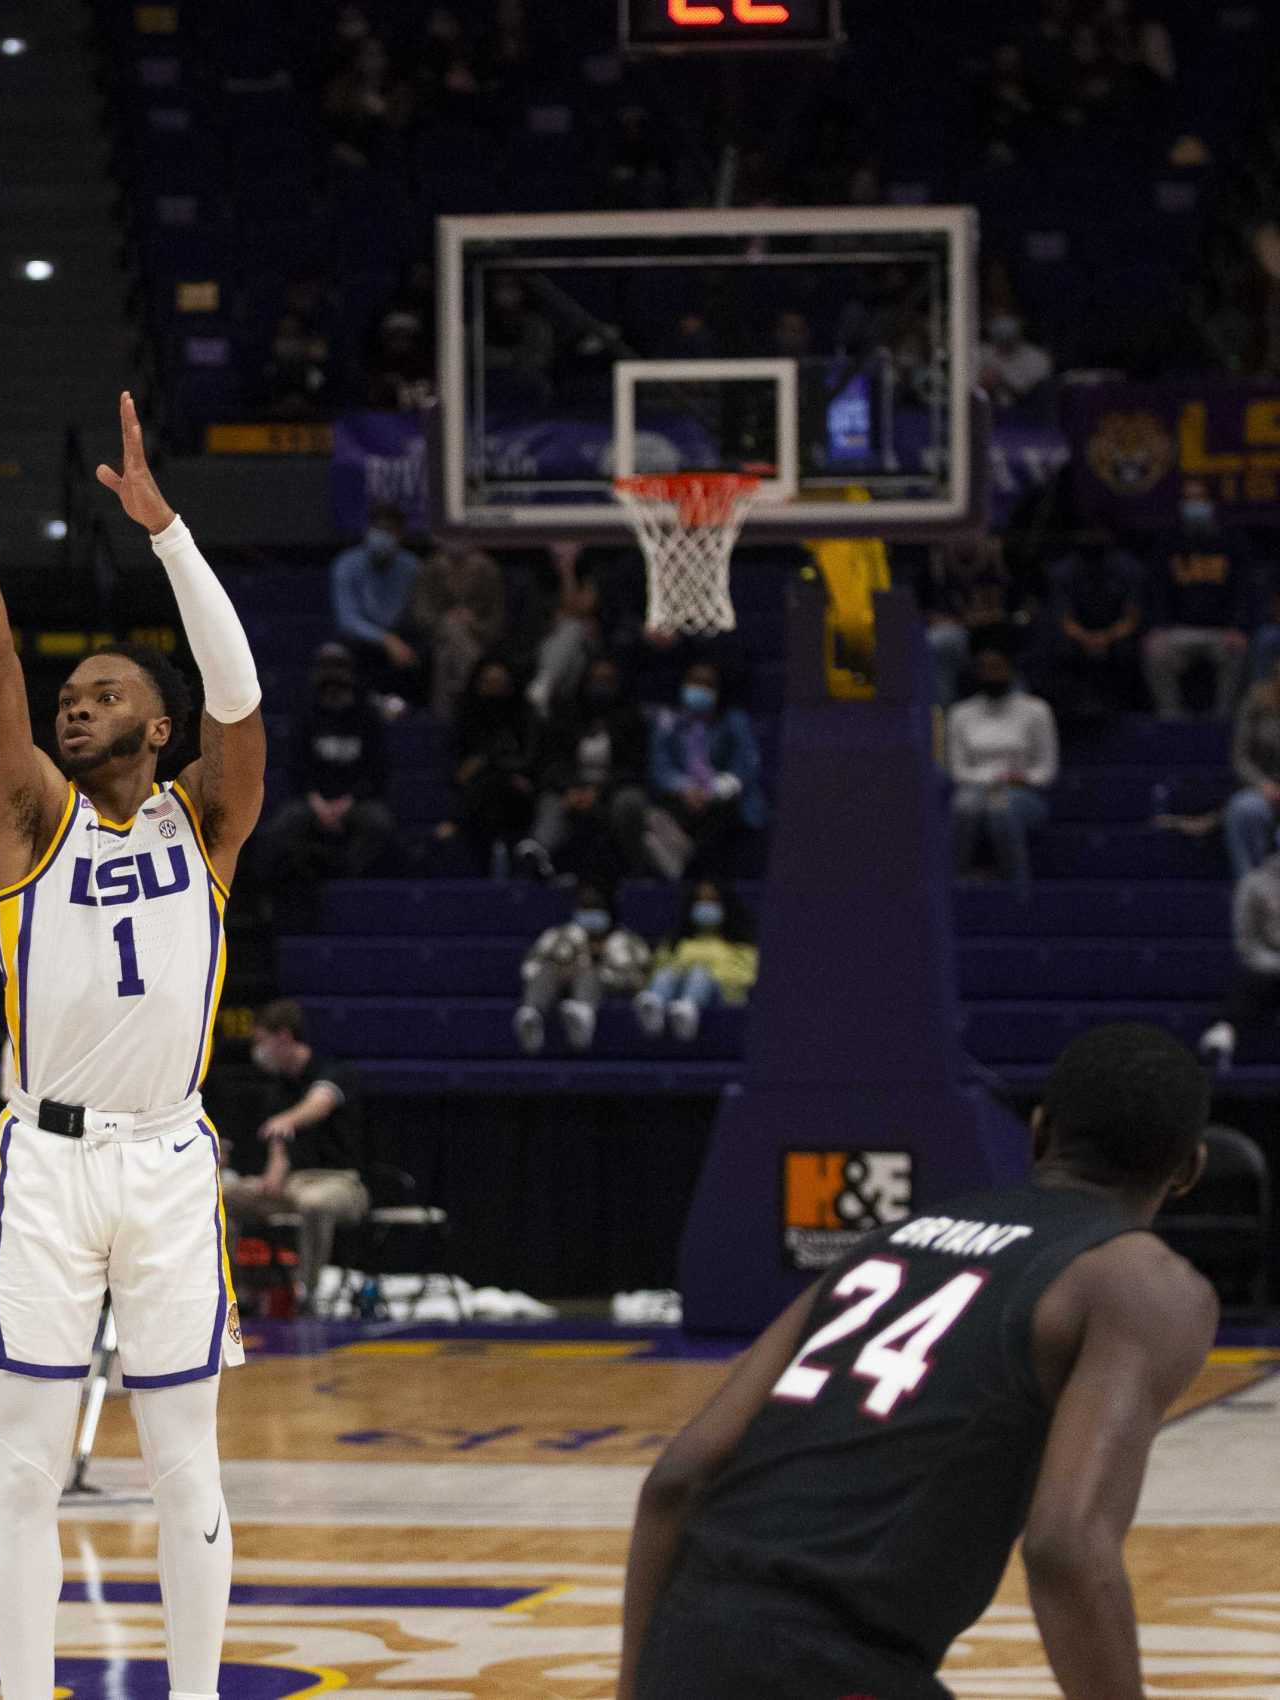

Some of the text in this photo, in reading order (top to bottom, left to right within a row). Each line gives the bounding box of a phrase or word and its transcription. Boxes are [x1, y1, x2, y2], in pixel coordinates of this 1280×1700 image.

[70, 844, 190, 907] LSU
[113, 917, 145, 997] 1
[784, 1152, 912, 1229] H&E
[888, 1215, 1035, 1257] BRYANT
[770, 1254, 991, 1423] 24
